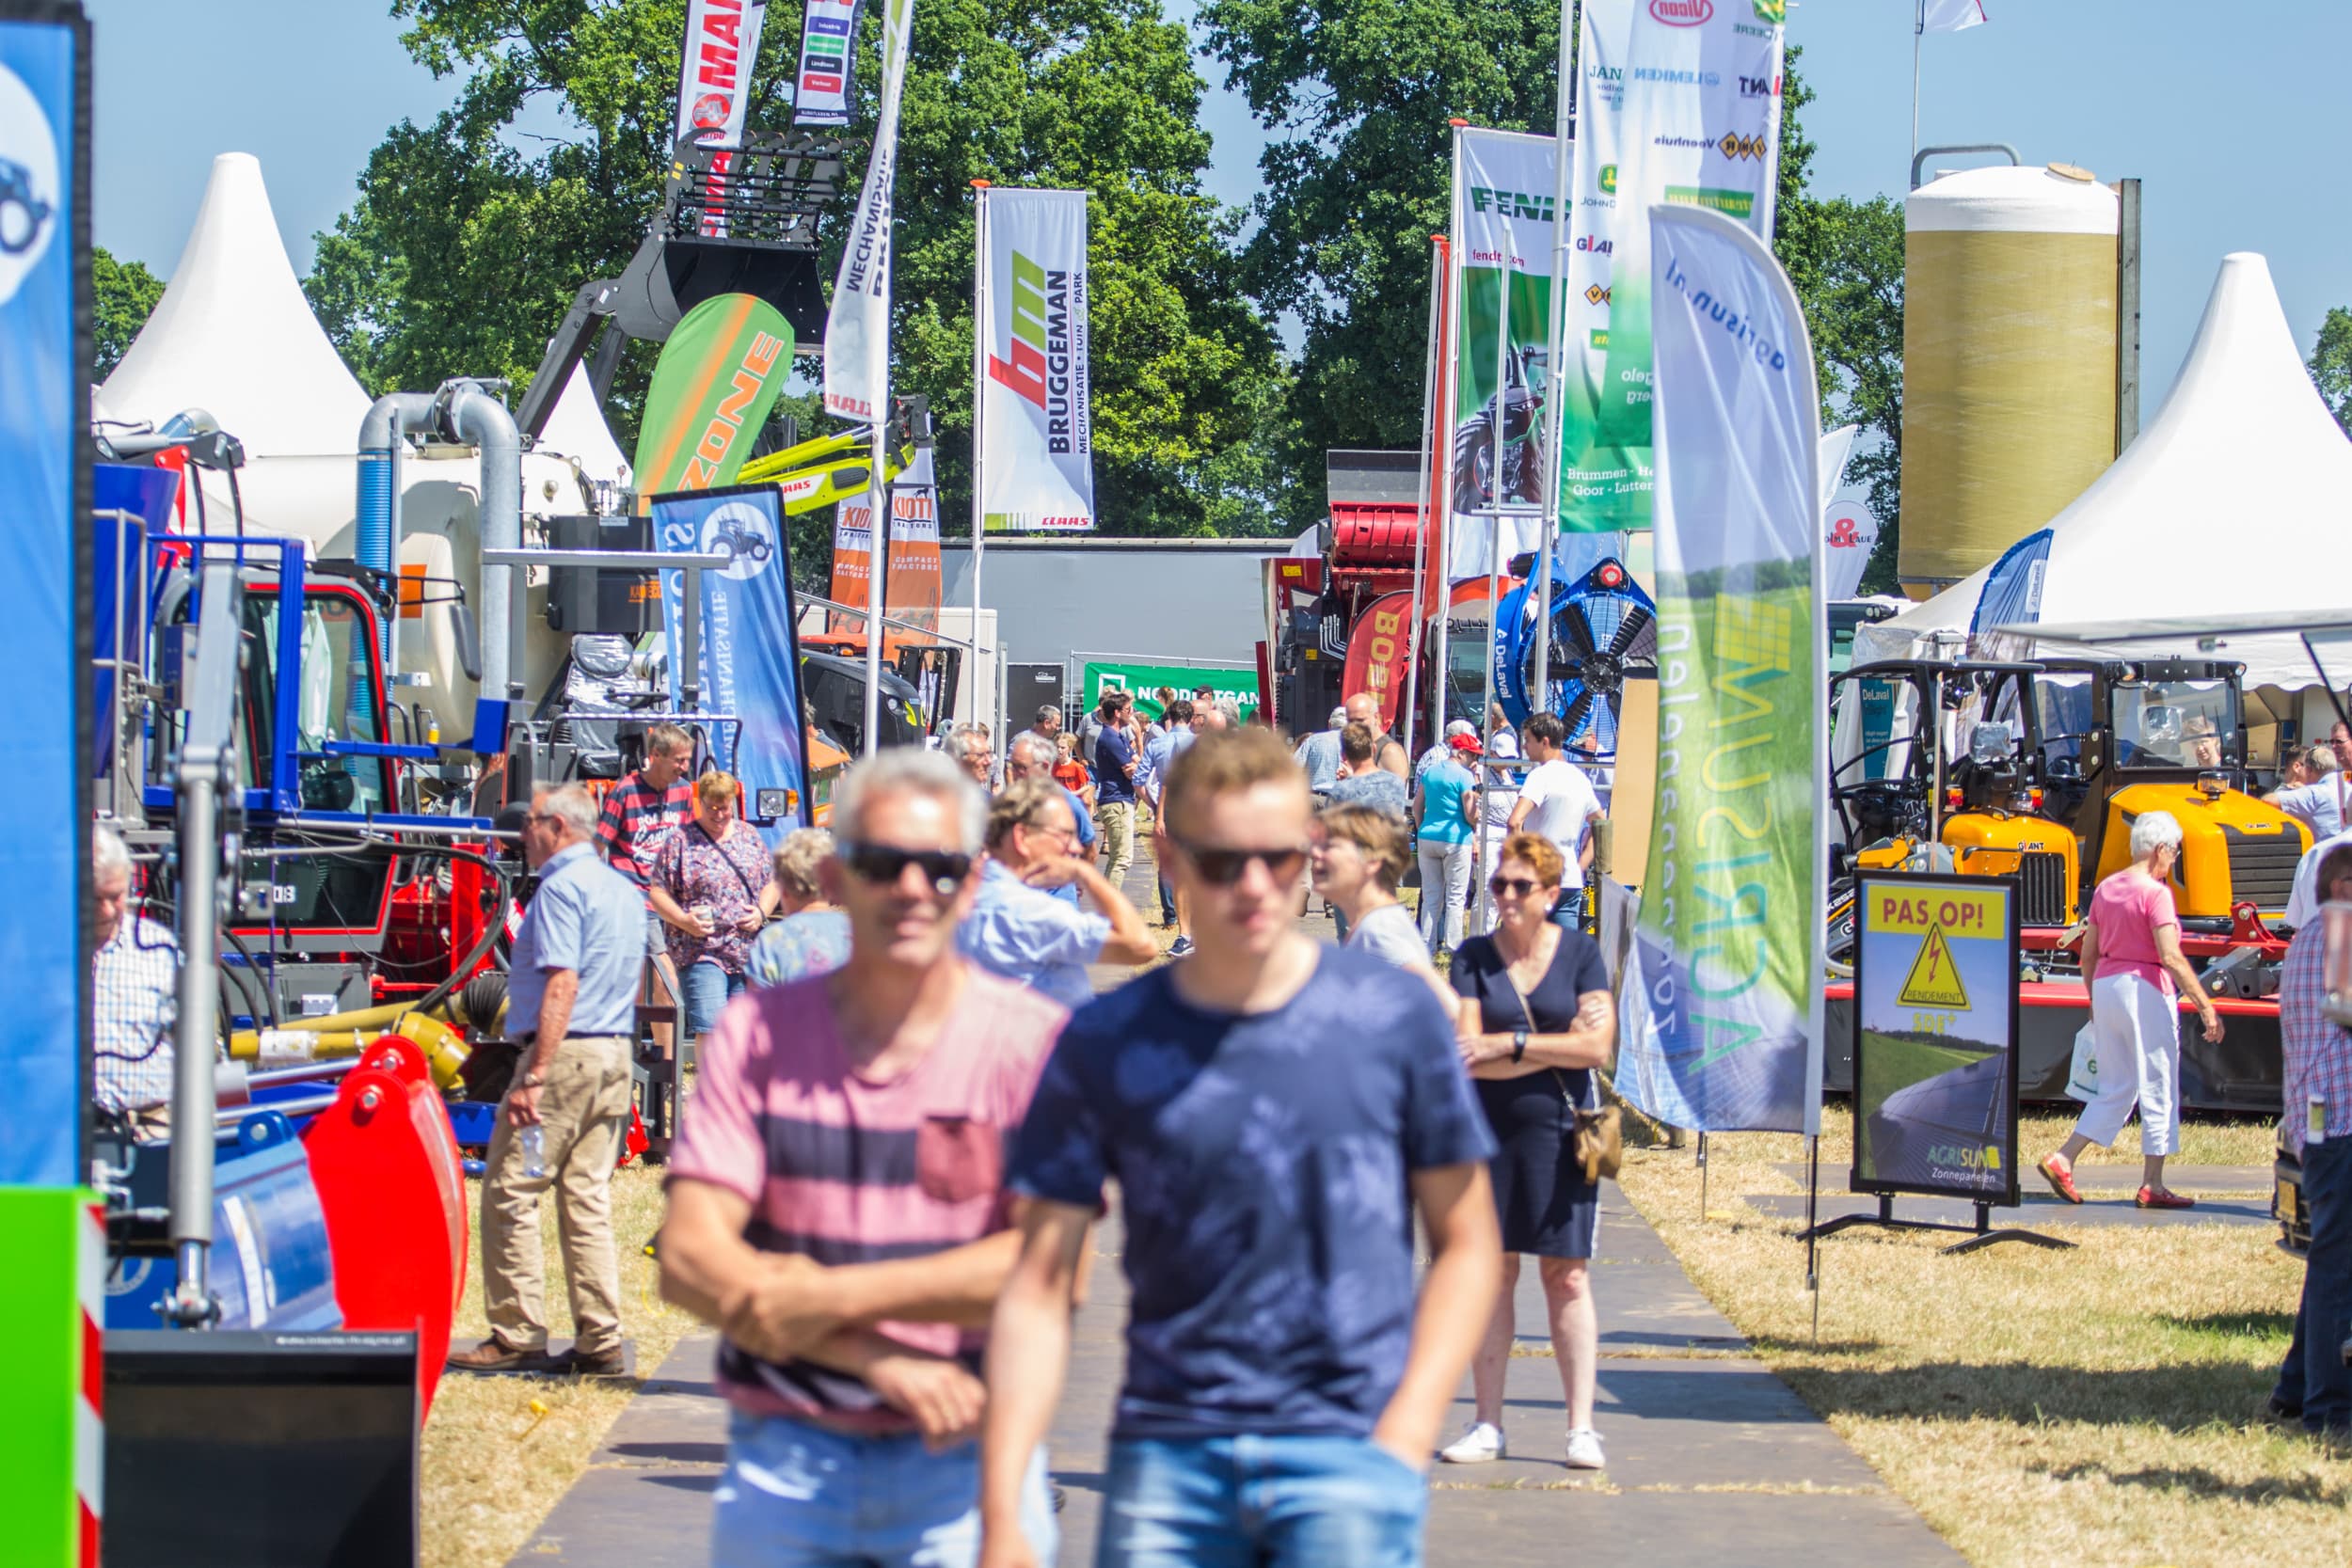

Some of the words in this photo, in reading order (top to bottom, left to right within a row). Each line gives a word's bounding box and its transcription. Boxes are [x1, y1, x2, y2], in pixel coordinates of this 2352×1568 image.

[1470, 186, 1572, 222] FEND
[1581, 196, 1609, 208] JOHN
[1472, 249, 1525, 267] fendtom
[1073, 271, 1083, 303] PARK
[1047, 270, 1071, 454] BRUGGEMAN
[678, 330, 785, 491] ZONE
[1073, 362, 1088, 454] MECHANISATIE
[1566, 467, 1627, 481] Brummen
[783, 480, 811, 494] AAS
[1572, 484, 1604, 496] Goor
[1041, 516, 1089, 527] CLAAS
[1495, 645, 1512, 699] DeLaval
[1862, 689, 1889, 701] DeLaval
[1883, 897, 1929, 926] PAS
[1938, 900, 1983, 929] OP!
[1906, 989, 1962, 1003] RENDEMENT
[1928, 1146, 1988, 1168] AGRISUN
[1931, 1167, 1995, 1184] Zonnepanelen
